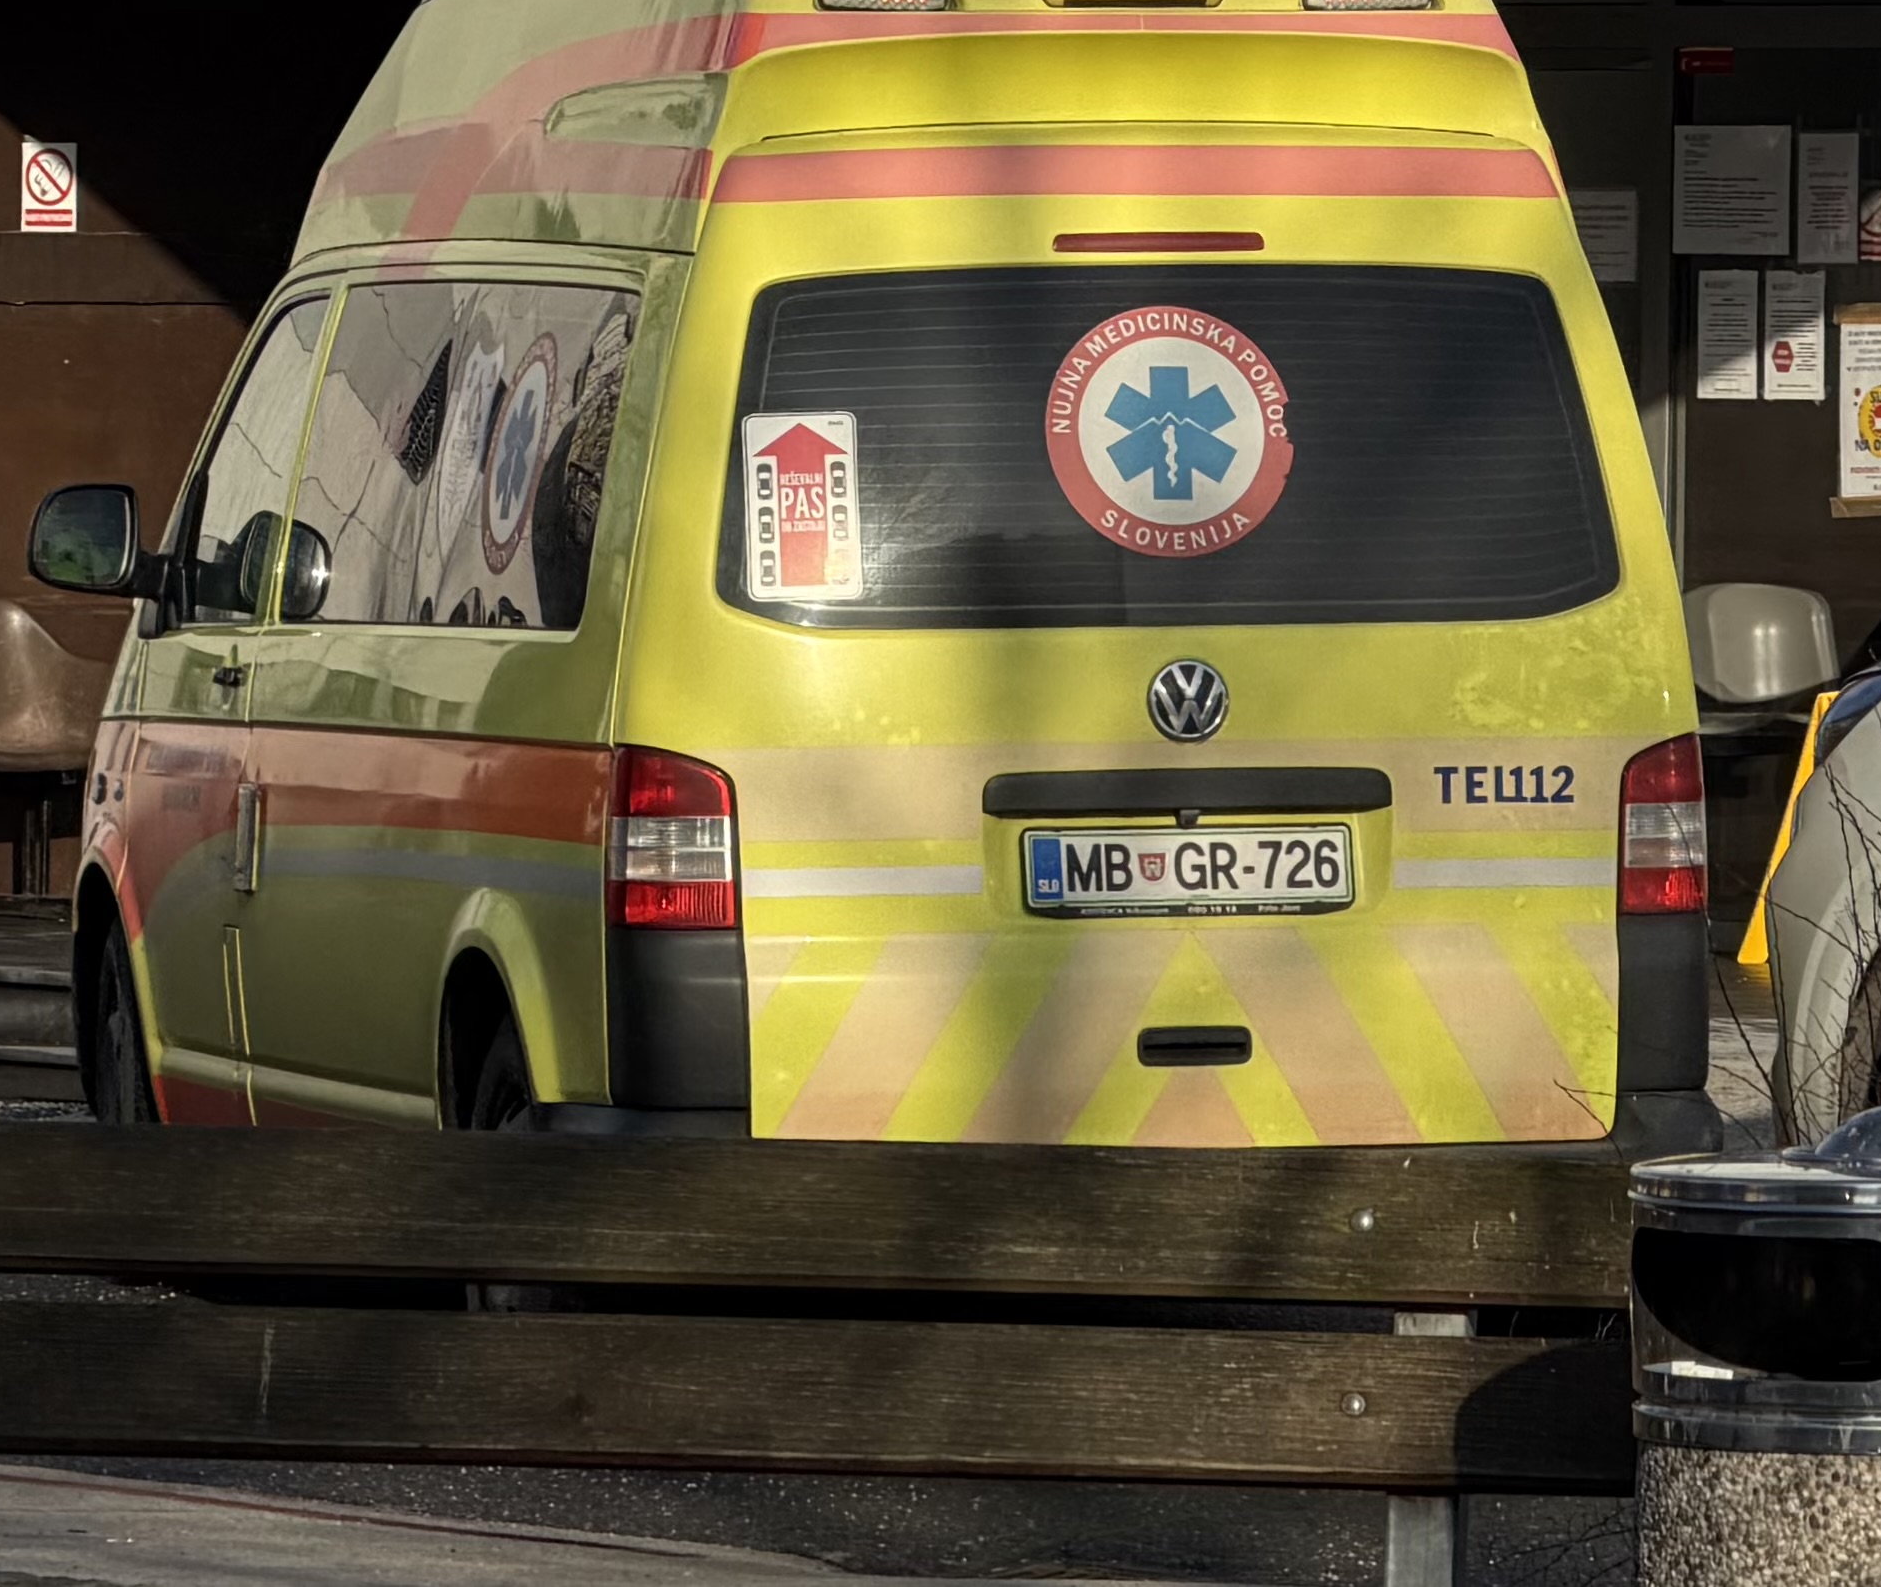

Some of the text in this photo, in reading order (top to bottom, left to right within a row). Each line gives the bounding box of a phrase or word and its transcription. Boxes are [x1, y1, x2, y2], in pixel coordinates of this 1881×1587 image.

[1053, 357, 1091, 433] NUJNA
[1085, 312, 1236, 355] MEDICINSKA
[780, 487, 825, 519] PAS
[1101, 509, 1251, 551] SLOVENIJA
[1038, 839, 1341, 893] SLO MB GR-726
